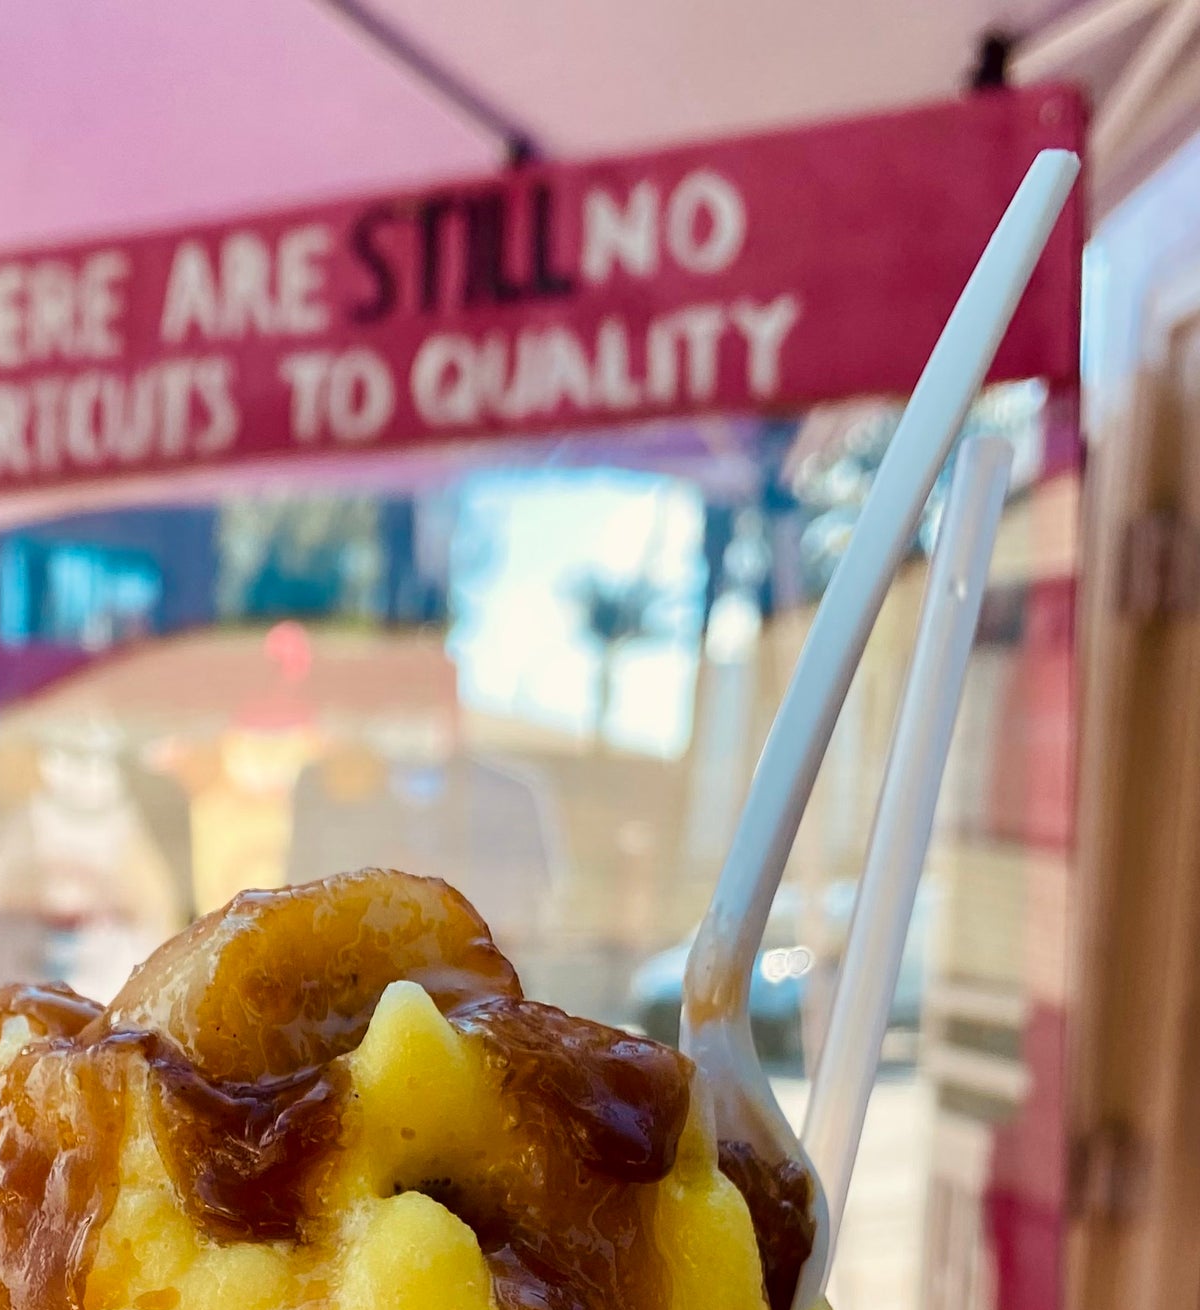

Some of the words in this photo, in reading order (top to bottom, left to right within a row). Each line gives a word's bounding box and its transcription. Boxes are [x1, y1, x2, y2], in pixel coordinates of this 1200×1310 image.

[158, 222, 332, 344] ARE
[345, 180, 575, 326] STILL
[581, 168, 748, 286] NO
[277, 341, 397, 446] TO
[410, 292, 798, 425] QUALITY
